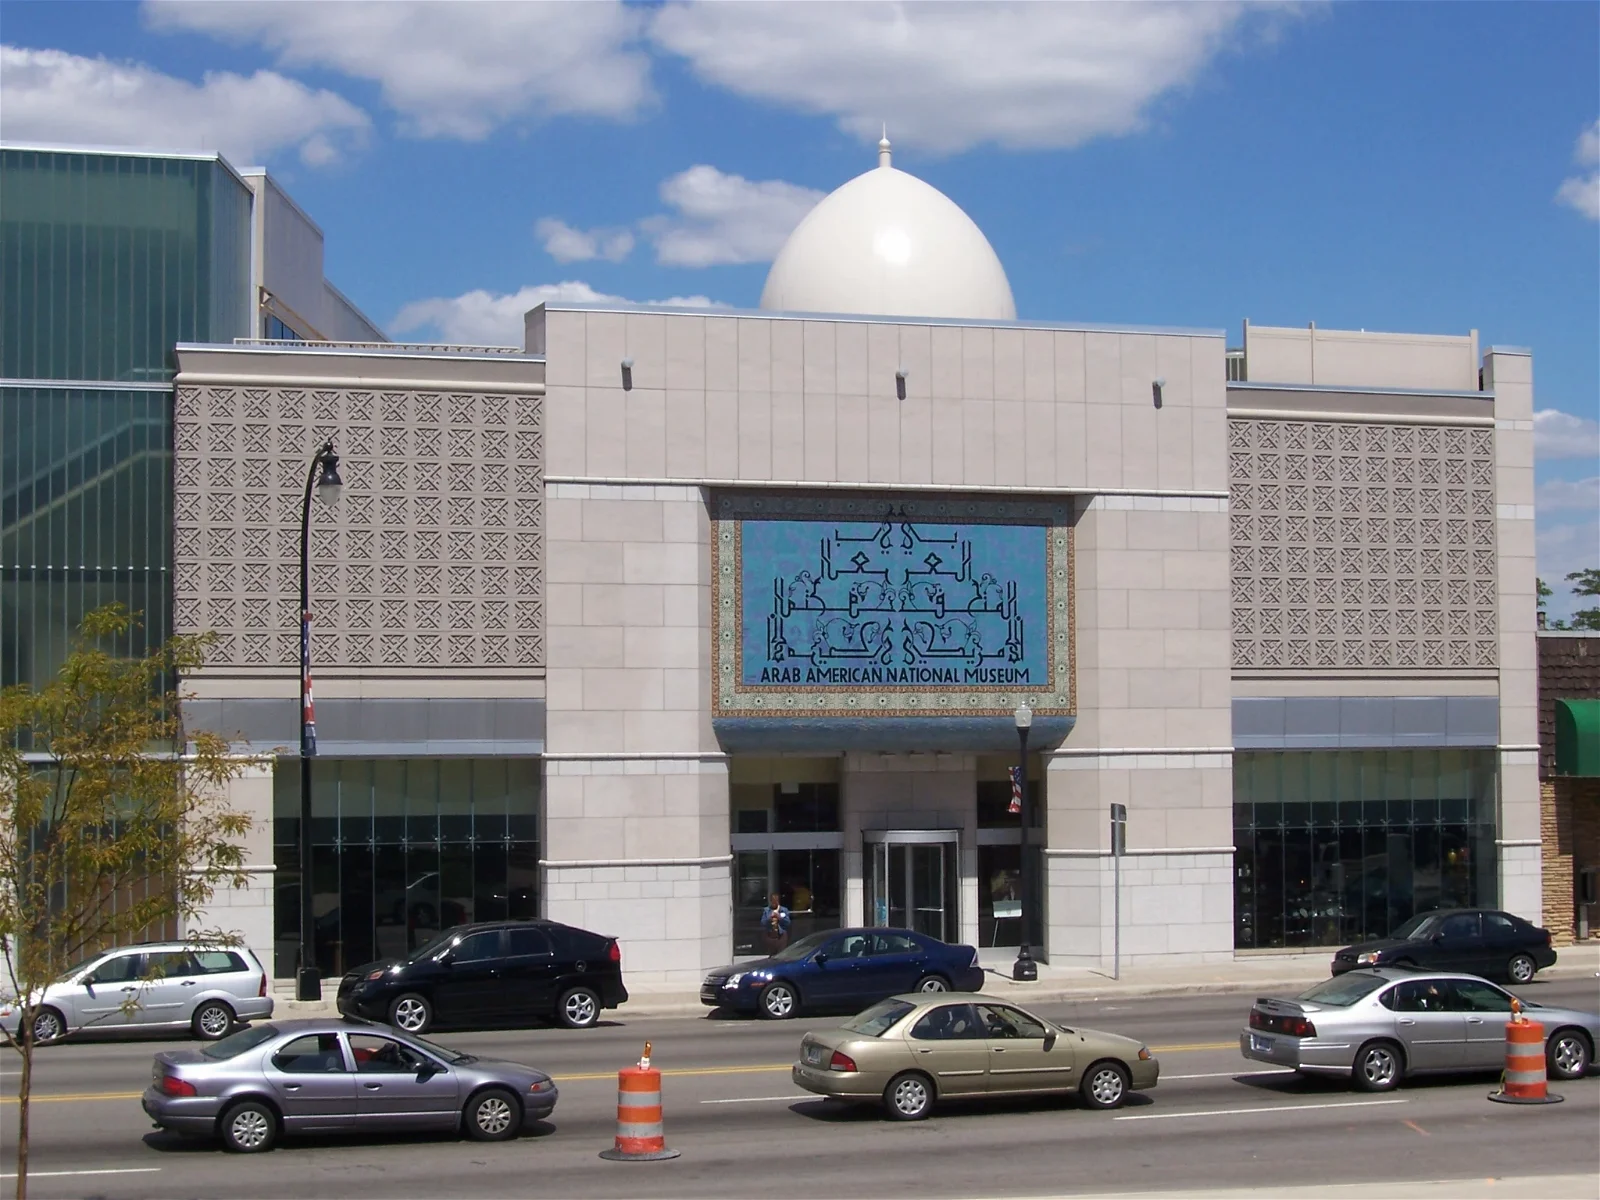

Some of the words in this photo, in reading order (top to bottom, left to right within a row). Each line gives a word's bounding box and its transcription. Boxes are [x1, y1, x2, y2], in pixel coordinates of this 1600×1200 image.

[760, 667, 801, 683] ARAB
[806, 667, 882, 683] AMERICAN
[886, 667, 960, 683] NATIONAL
[964, 667, 1030, 683] MUSEUM
